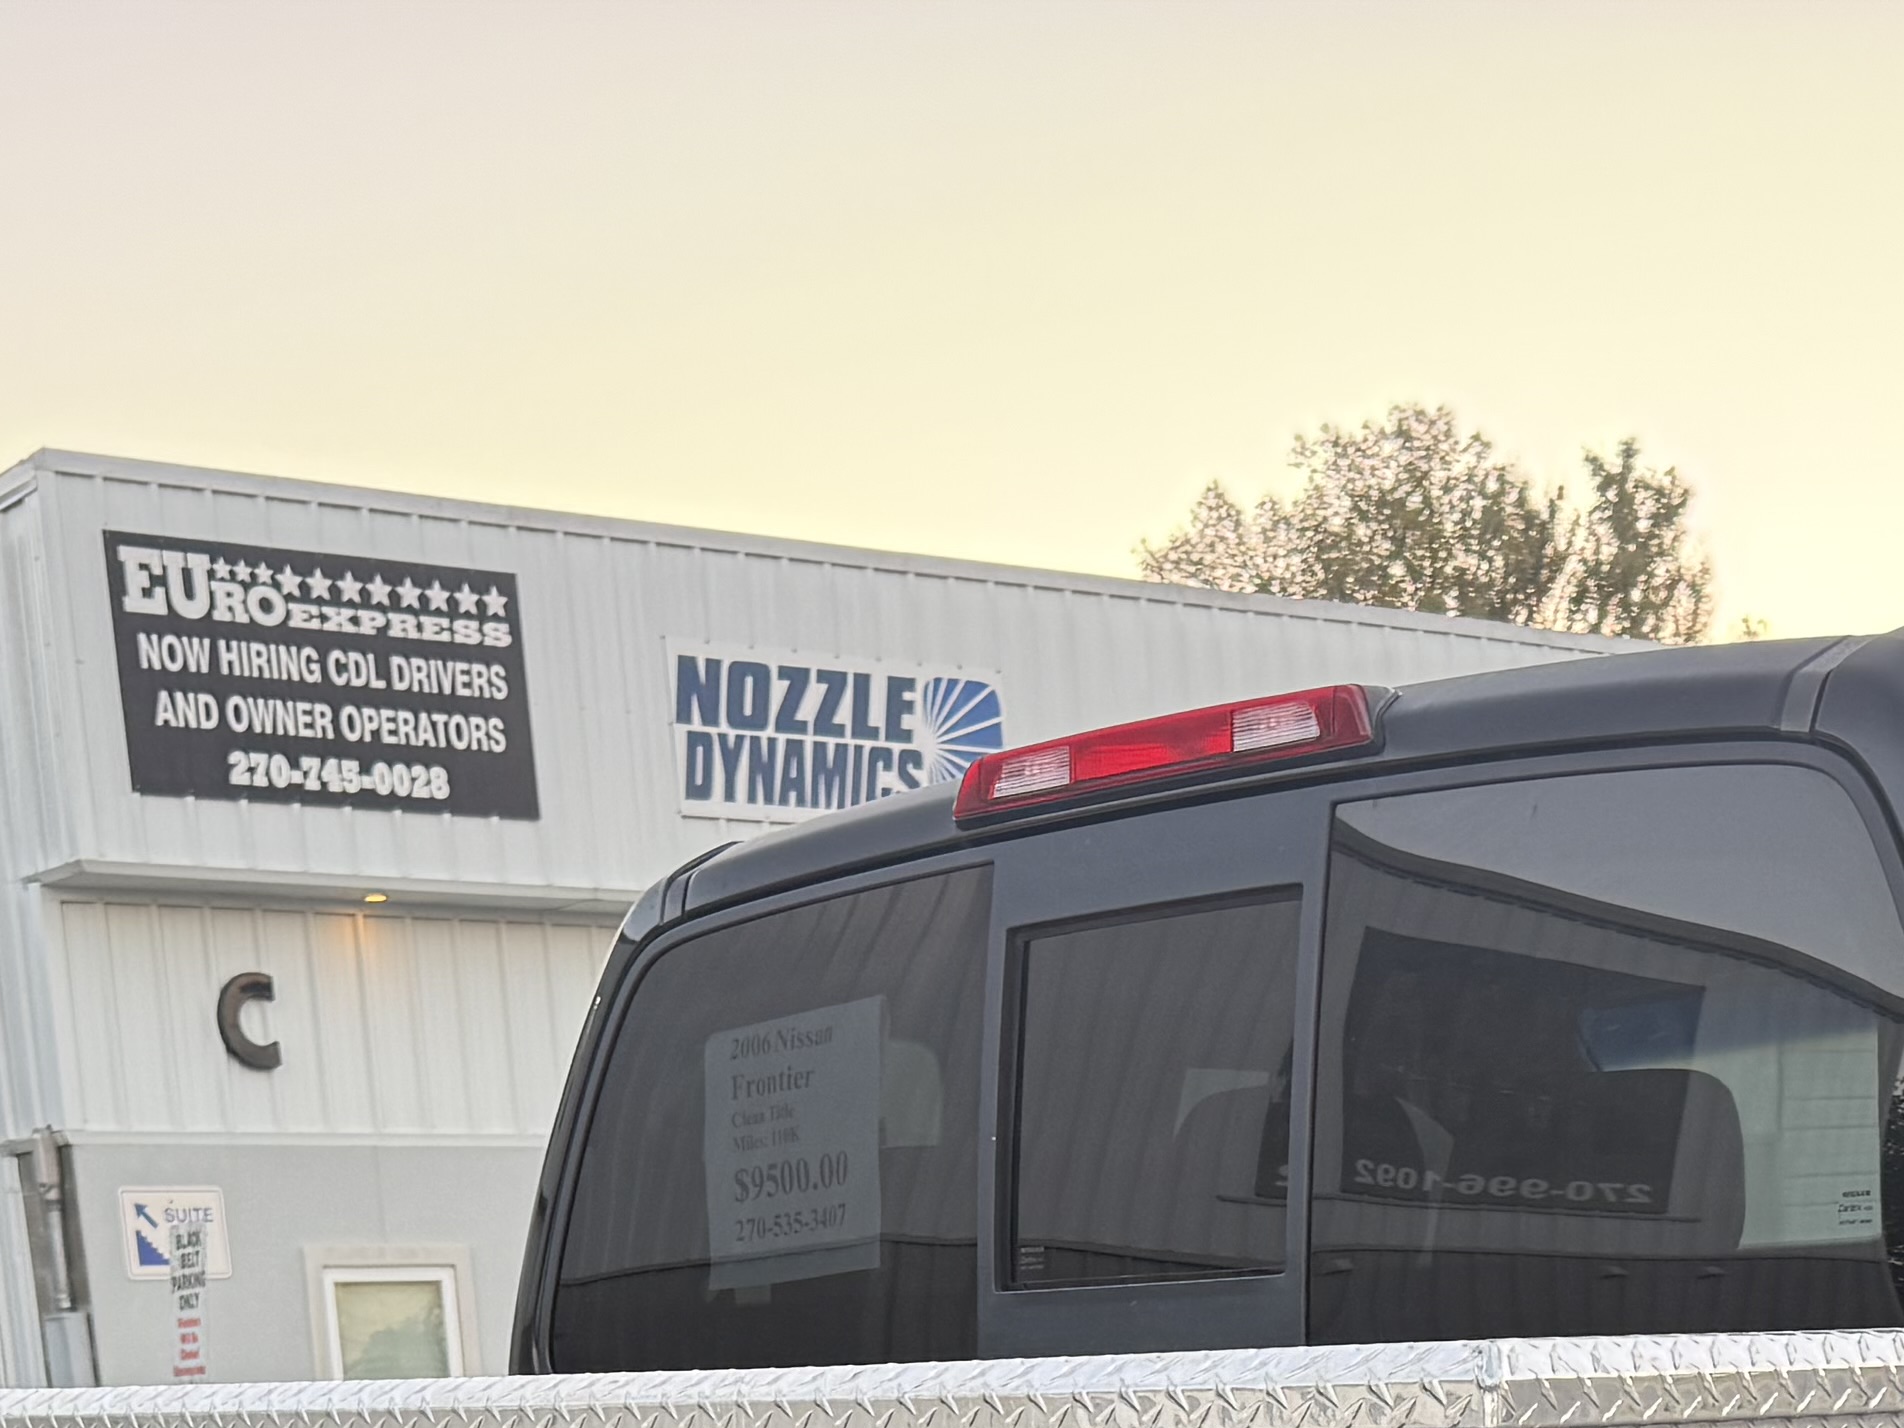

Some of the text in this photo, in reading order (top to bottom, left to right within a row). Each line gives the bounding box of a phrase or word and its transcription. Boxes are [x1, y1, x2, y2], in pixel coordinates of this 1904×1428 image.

[286, 602, 512, 648] EXPRESS
[137, 632, 509, 701] NOW HIRING CDL DRIVERS
[155, 690, 507, 753] AND OWNER OPERATORS
[676, 654, 917, 744] NOZZLE
[227, 750, 451, 800] 270-745-0028
[685, 730, 924, 809] DYNAMICS
[217, 972, 282, 1072] C
[730, 1025, 834, 1060] 2006 Nissan
[732, 1066, 815, 1101] Frontier
[734, 1150, 849, 1203] $9500.00
[164, 1207, 214, 1223] SUITE
[735, 1203, 847, 1242] 270-535-3407
